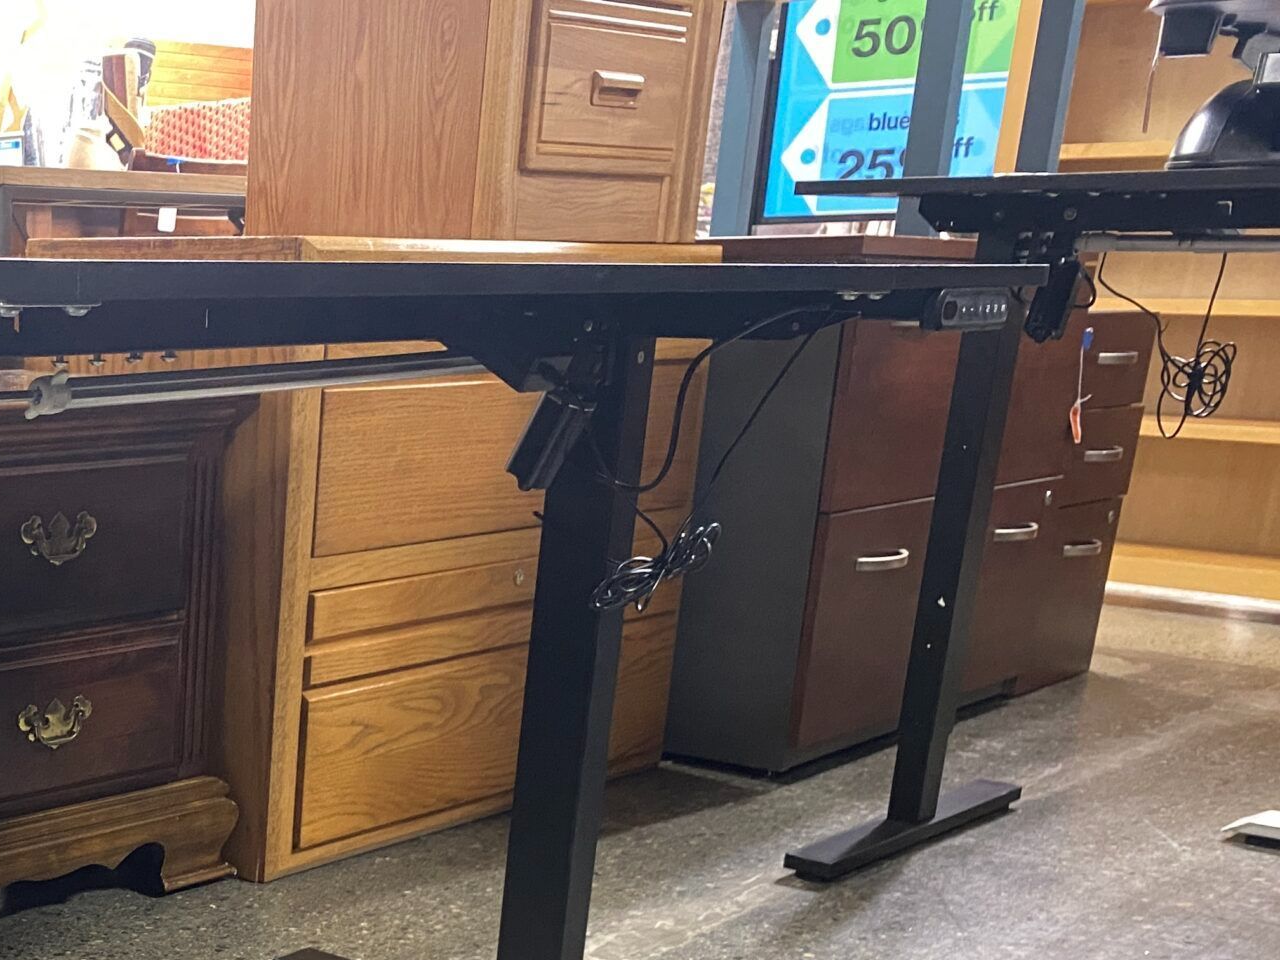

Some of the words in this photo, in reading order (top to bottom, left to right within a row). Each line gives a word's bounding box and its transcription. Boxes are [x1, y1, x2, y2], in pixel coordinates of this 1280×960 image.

[852, 15, 925, 57] 50
[868, 112, 911, 131] blue
[837, 147, 906, 180] 25
[953, 136, 975, 159] ff
